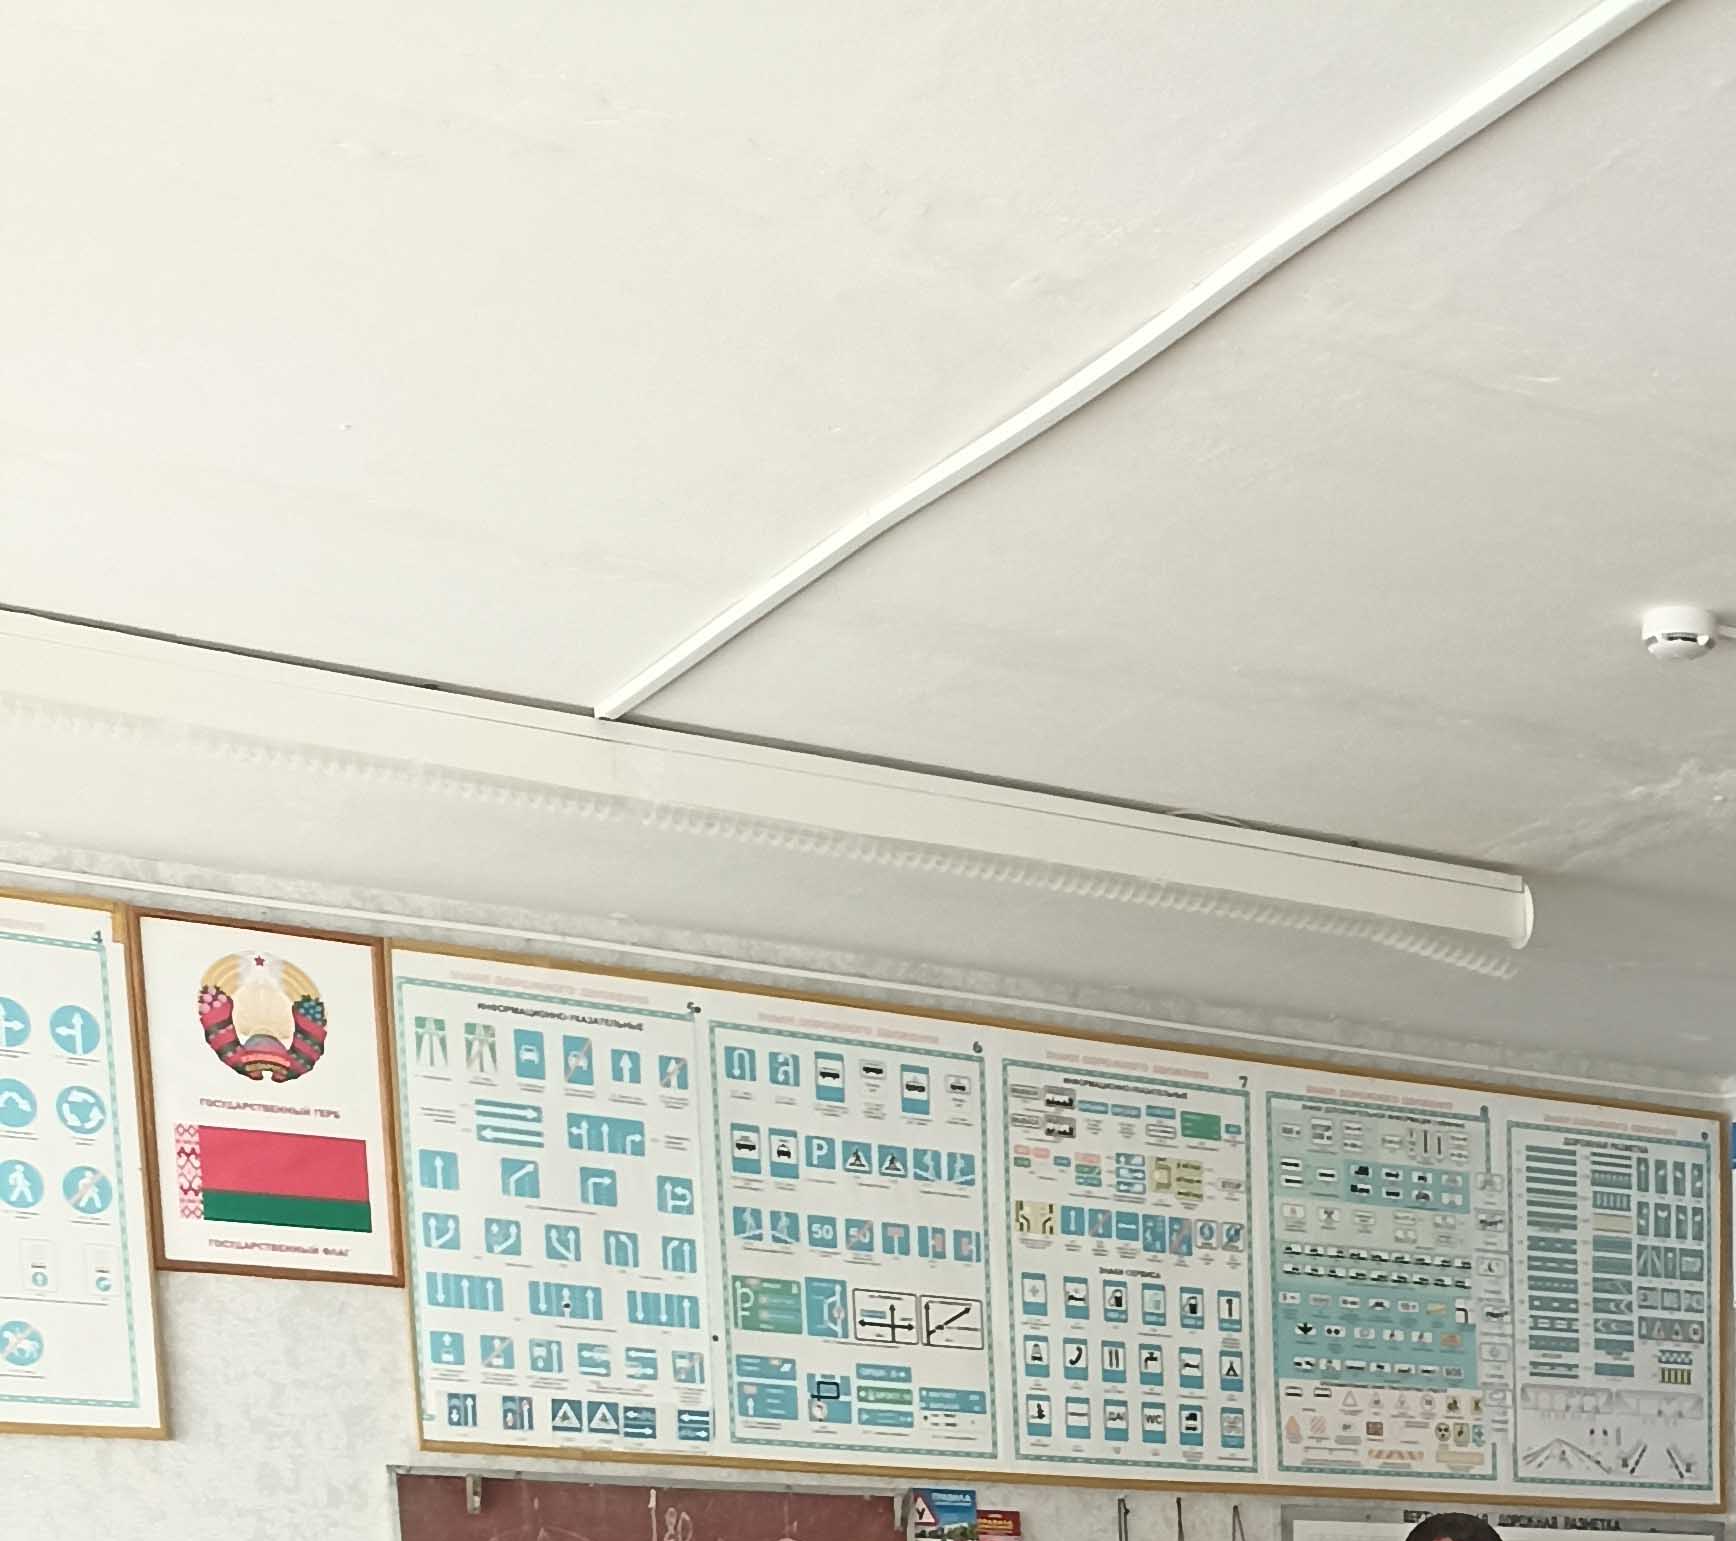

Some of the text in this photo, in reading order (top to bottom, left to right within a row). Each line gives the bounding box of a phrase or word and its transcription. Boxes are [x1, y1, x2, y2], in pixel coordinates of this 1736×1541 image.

[199, 1097, 341, 1119] ГОСУДАРСТВЕННЫЙ ГЕРБ
[811, 1224, 834, 1241] 50
[208, 1239, 351, 1257] ГОСУДАРСТВЕННЫЙ ФЛАГ
[1564, 1517, 1622, 1531] РАЗМЕТКА
